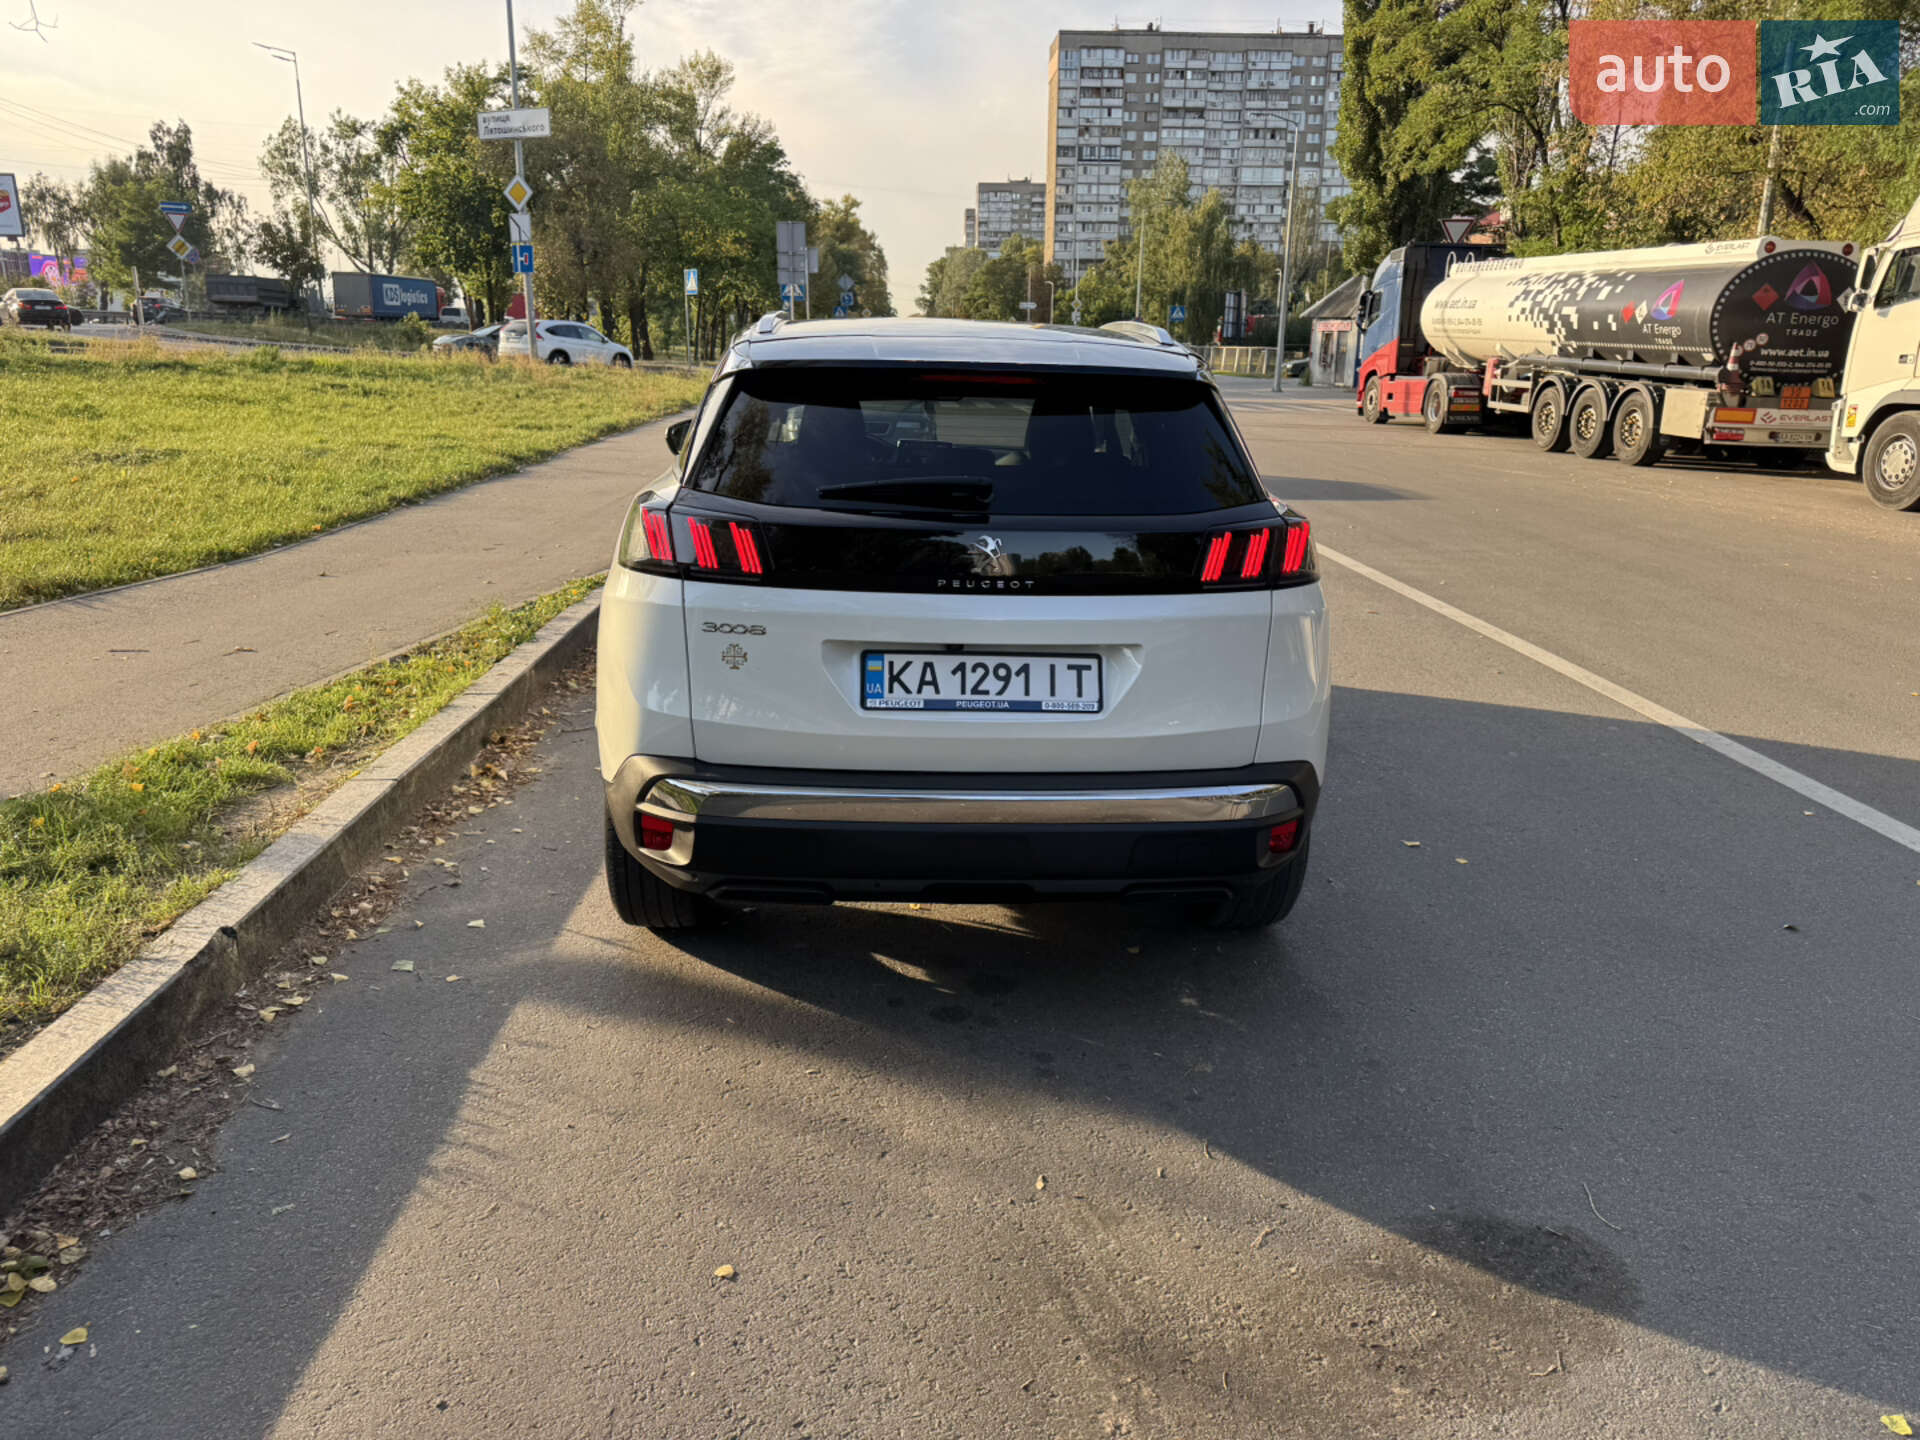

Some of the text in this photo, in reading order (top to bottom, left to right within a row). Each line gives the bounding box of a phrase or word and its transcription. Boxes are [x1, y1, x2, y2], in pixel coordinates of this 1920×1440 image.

[1766, 312, 1839, 329] AT Energo
[1642, 323, 1682, 338] AT Energo
[1785, 329, 1819, 337] TRADE
[1760, 347, 1830, 358] www.aet.in.ua
[937, 579, 1035, 589] PEUGEOT
[701, 622, 767, 636] 3008
[887, 660, 1092, 698] KA 1291 IT
[866, 682, 883, 695] UA
[955, 700, 1010, 709] PEUGEOT.UA
